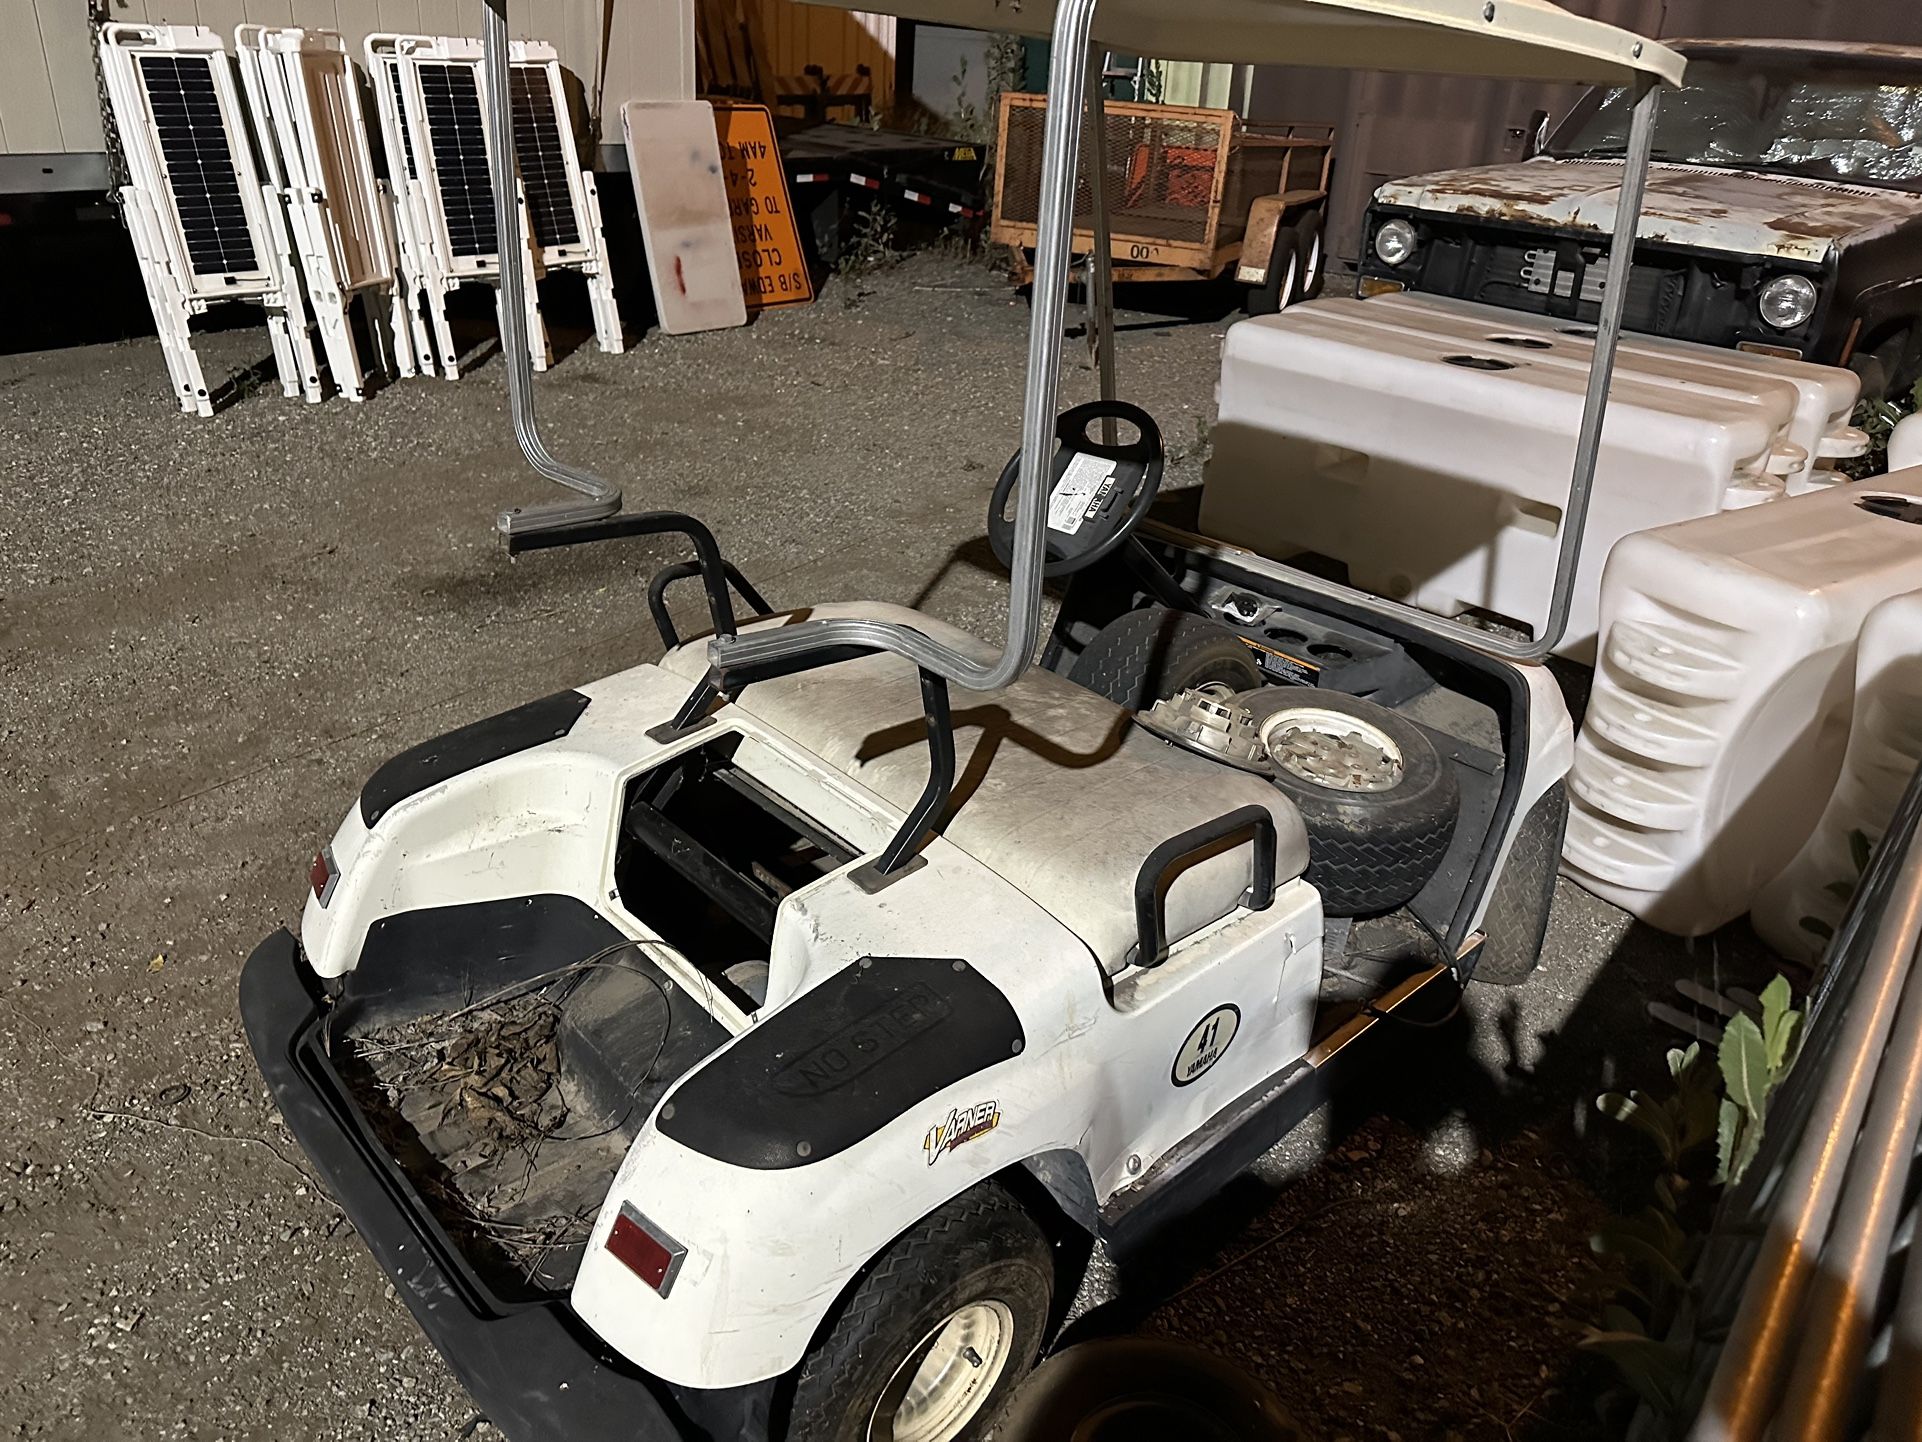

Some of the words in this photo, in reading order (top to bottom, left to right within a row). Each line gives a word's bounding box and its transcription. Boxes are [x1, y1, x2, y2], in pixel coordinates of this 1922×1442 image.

[738, 141, 767, 159] 4AM
[765, 196, 780, 214] TO
[780, 272, 802, 291] S/B
[799, 1049, 850, 1088] NO
[850, 993, 930, 1053] STEP
[1197, 1016, 1220, 1054] 41
[928, 1100, 997, 1166] VARNER
